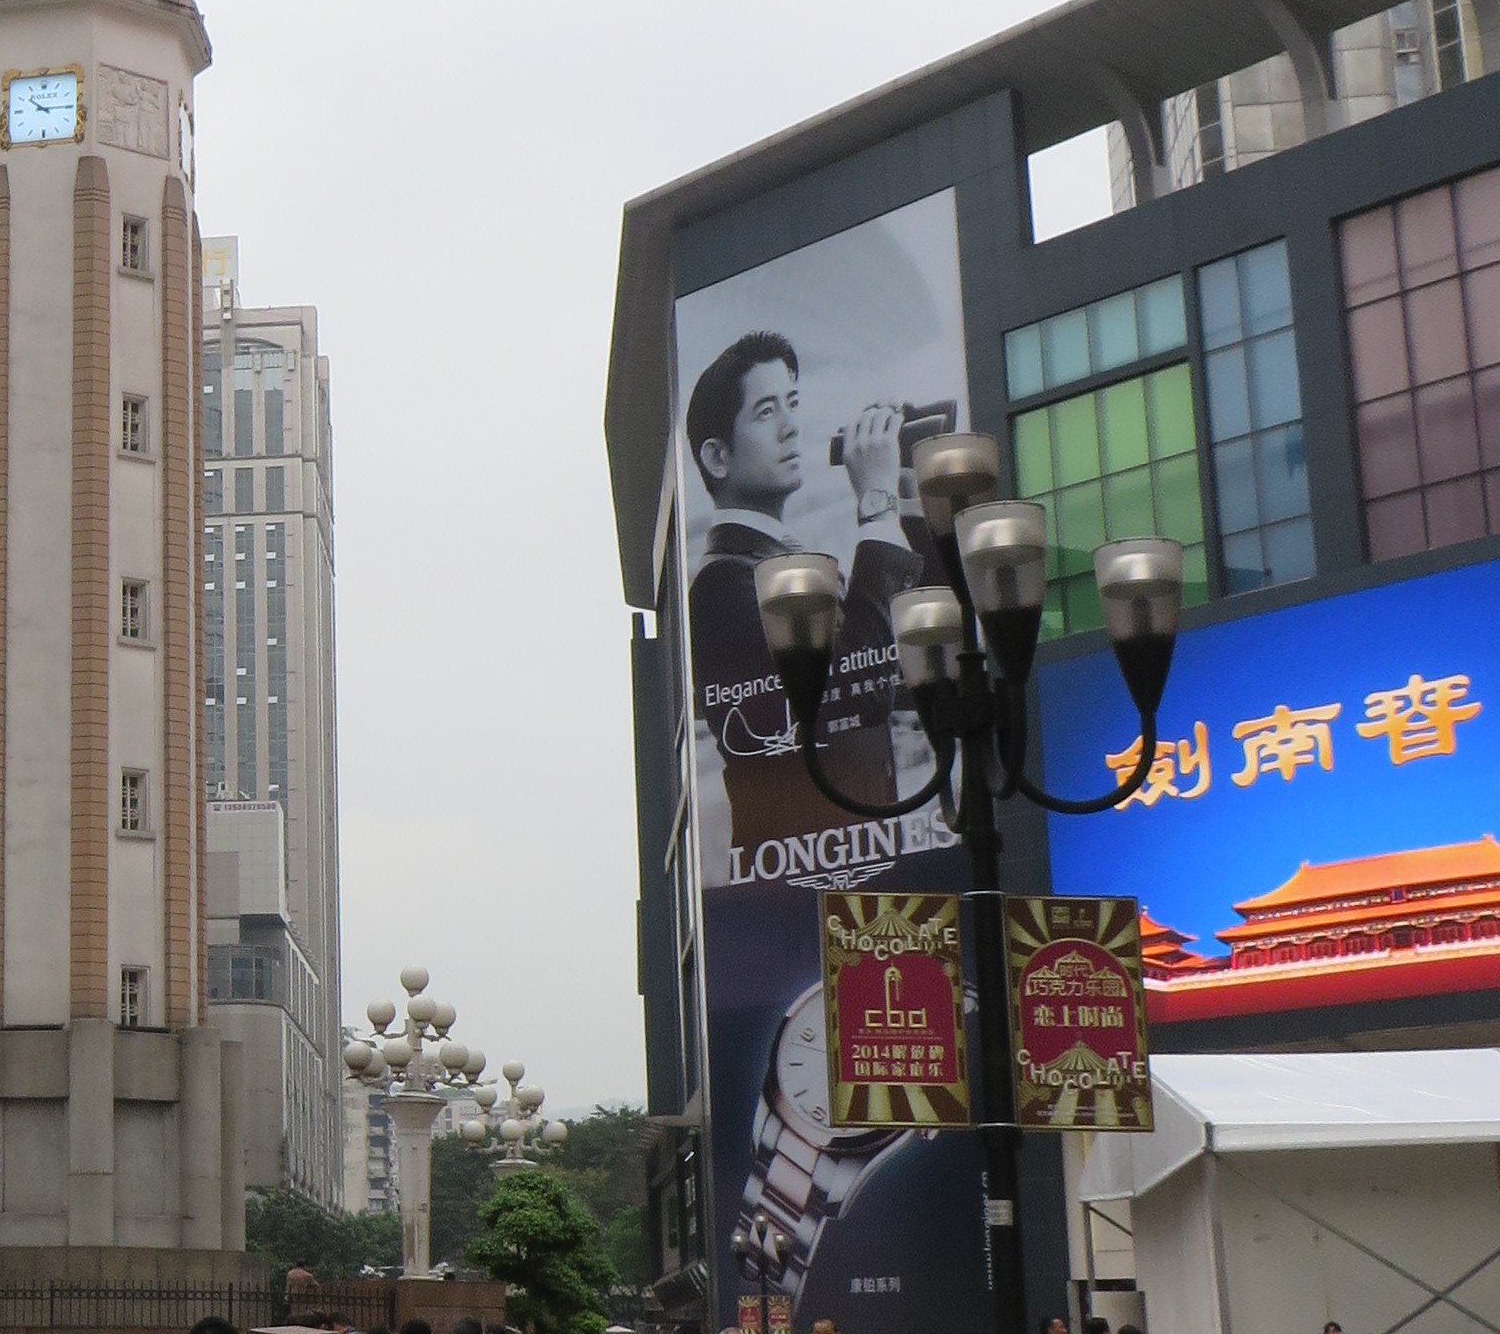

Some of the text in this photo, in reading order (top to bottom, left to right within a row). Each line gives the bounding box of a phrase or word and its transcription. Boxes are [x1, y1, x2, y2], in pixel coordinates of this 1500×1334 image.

[729, 811, 963, 887] LONGINES
[826, 915, 958, 961] CHOCOLATE
[1032, 979, 1122, 997] 巧克力乐园
[1016, 1049, 1148, 1095] CHOCOLATE
